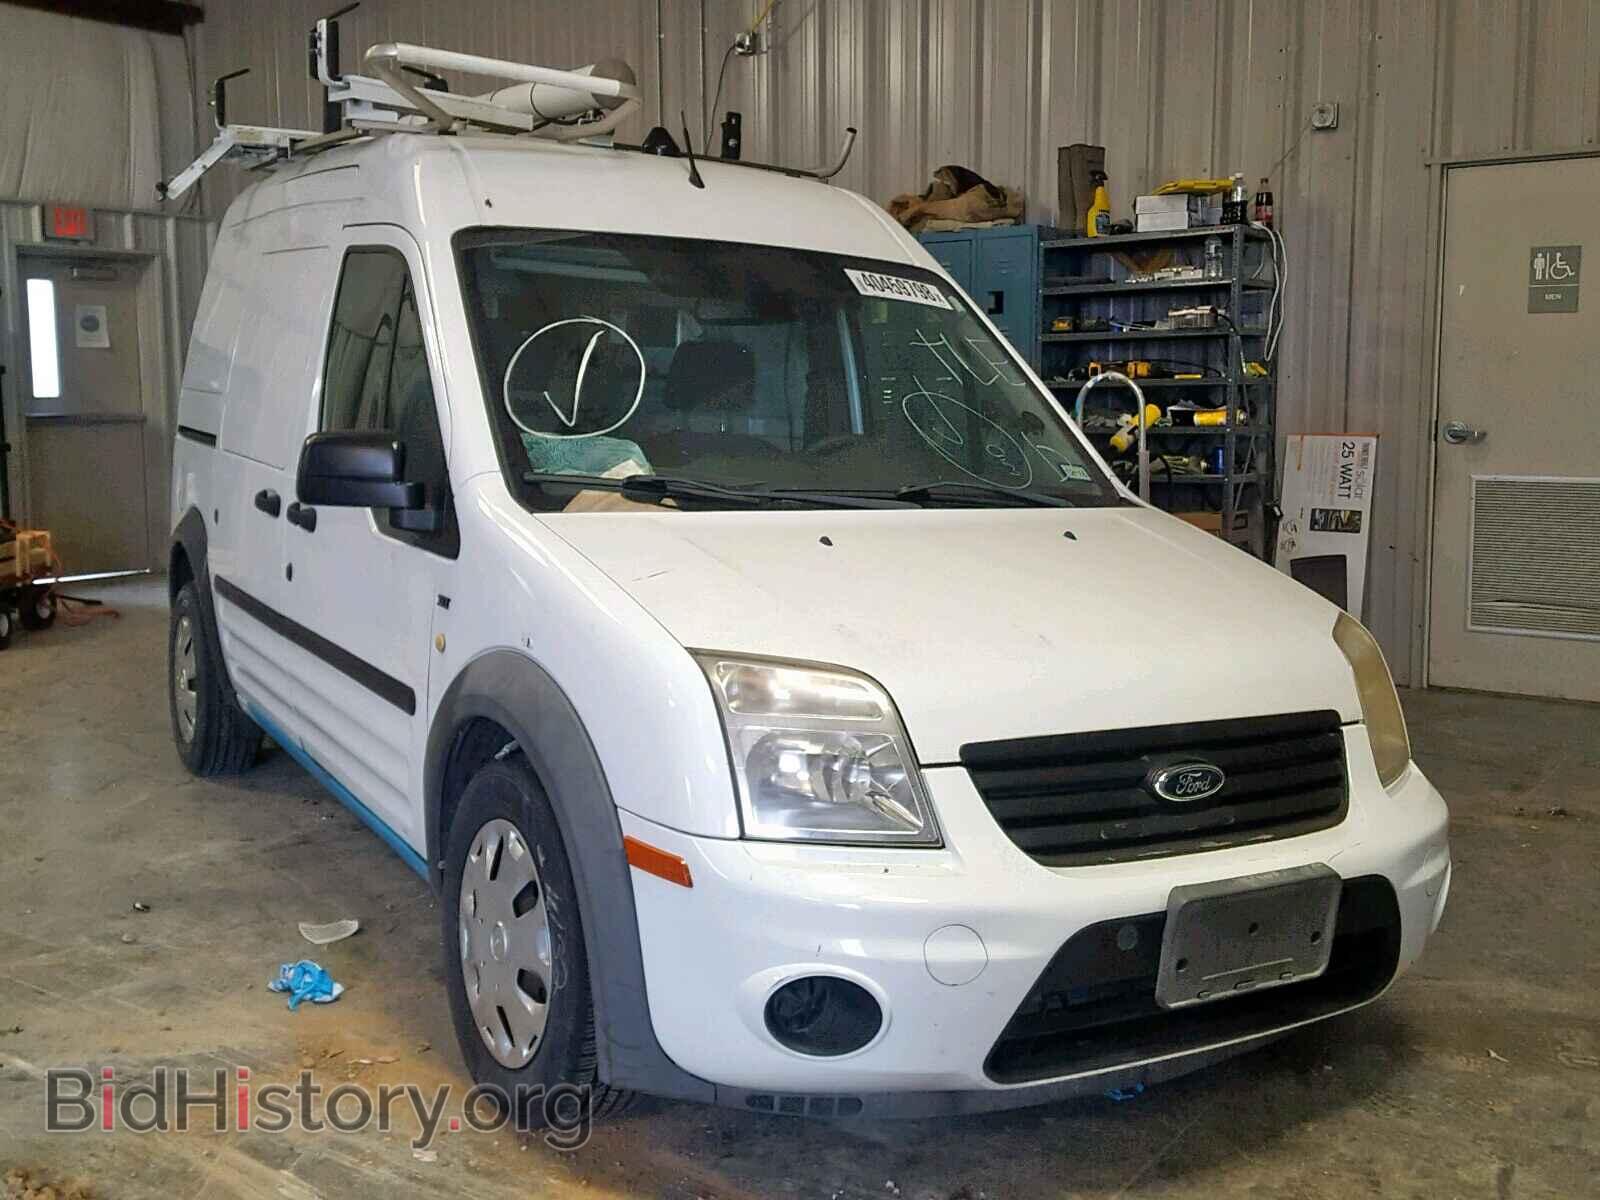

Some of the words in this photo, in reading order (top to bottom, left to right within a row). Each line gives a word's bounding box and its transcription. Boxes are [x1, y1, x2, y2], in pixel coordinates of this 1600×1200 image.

[861, 272, 938, 303] 40459798
[1341, 441, 1356, 459] 25
[1338, 463, 1353, 499] WATT
[1176, 772, 1212, 795] Ford
